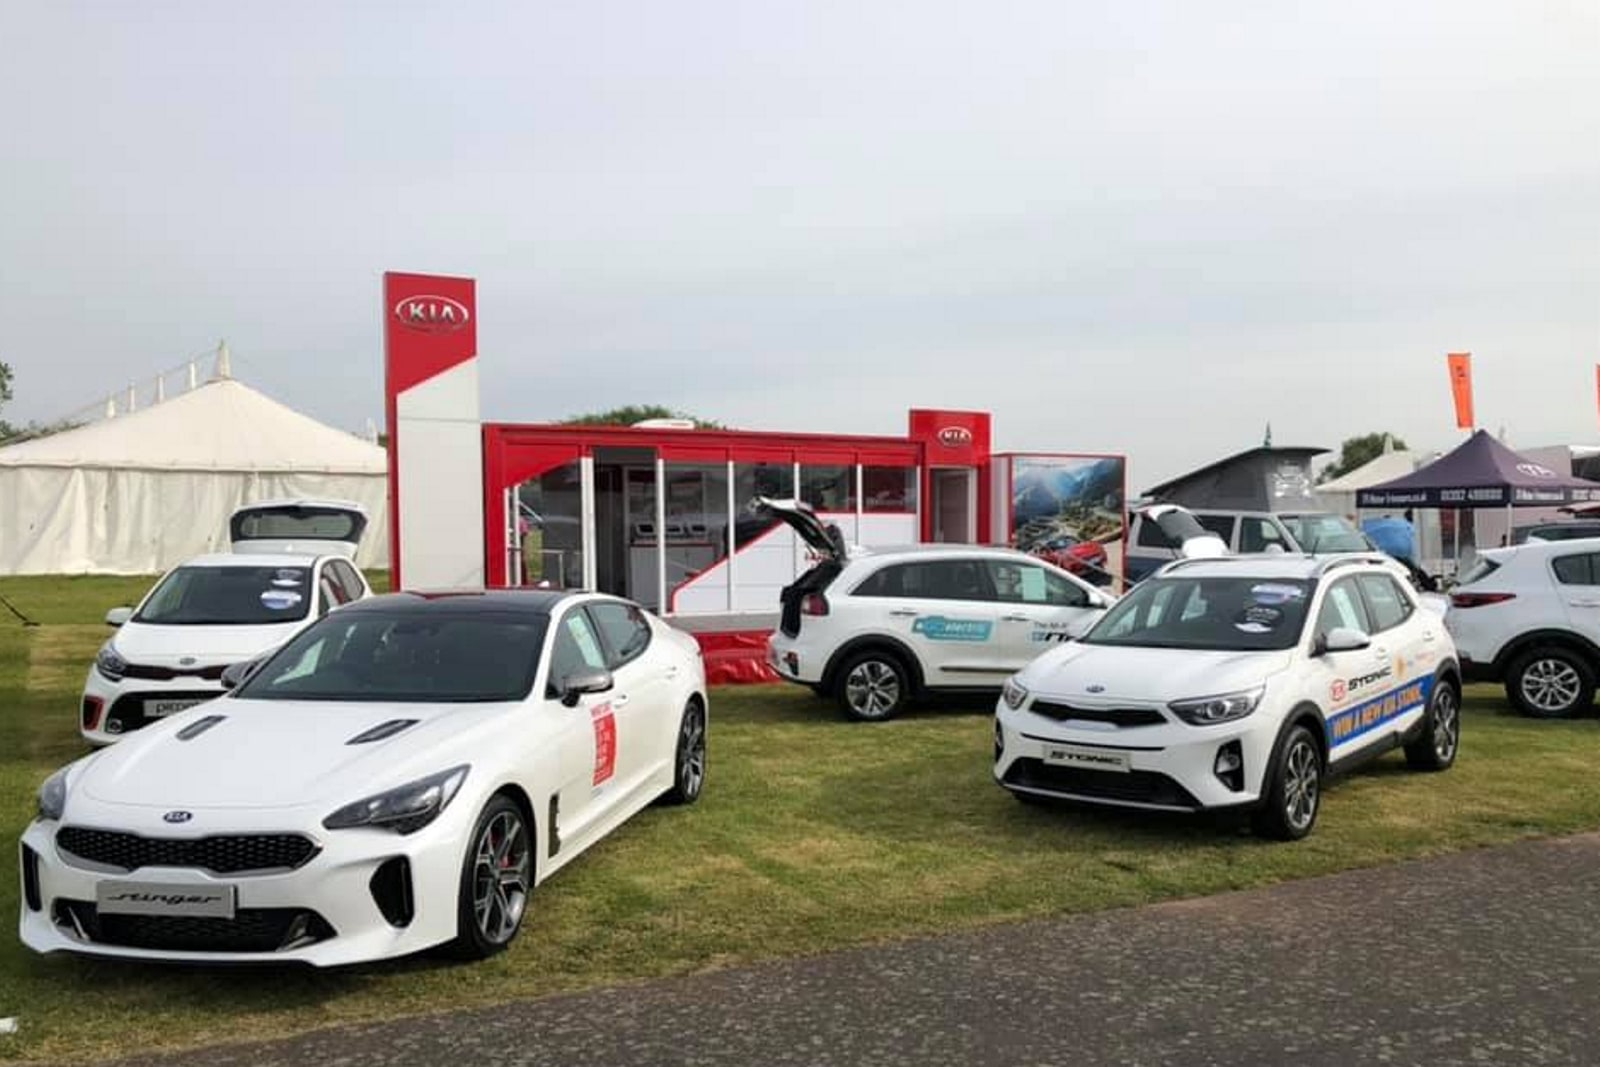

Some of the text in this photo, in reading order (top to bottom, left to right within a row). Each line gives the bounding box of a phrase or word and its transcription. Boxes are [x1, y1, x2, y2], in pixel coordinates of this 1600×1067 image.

[408, 302, 455, 323] KIA
[1333, 712, 1354, 737] WIN
[1361, 702, 1382, 727] NEW
[1050, 751, 1122, 765] STONIC
